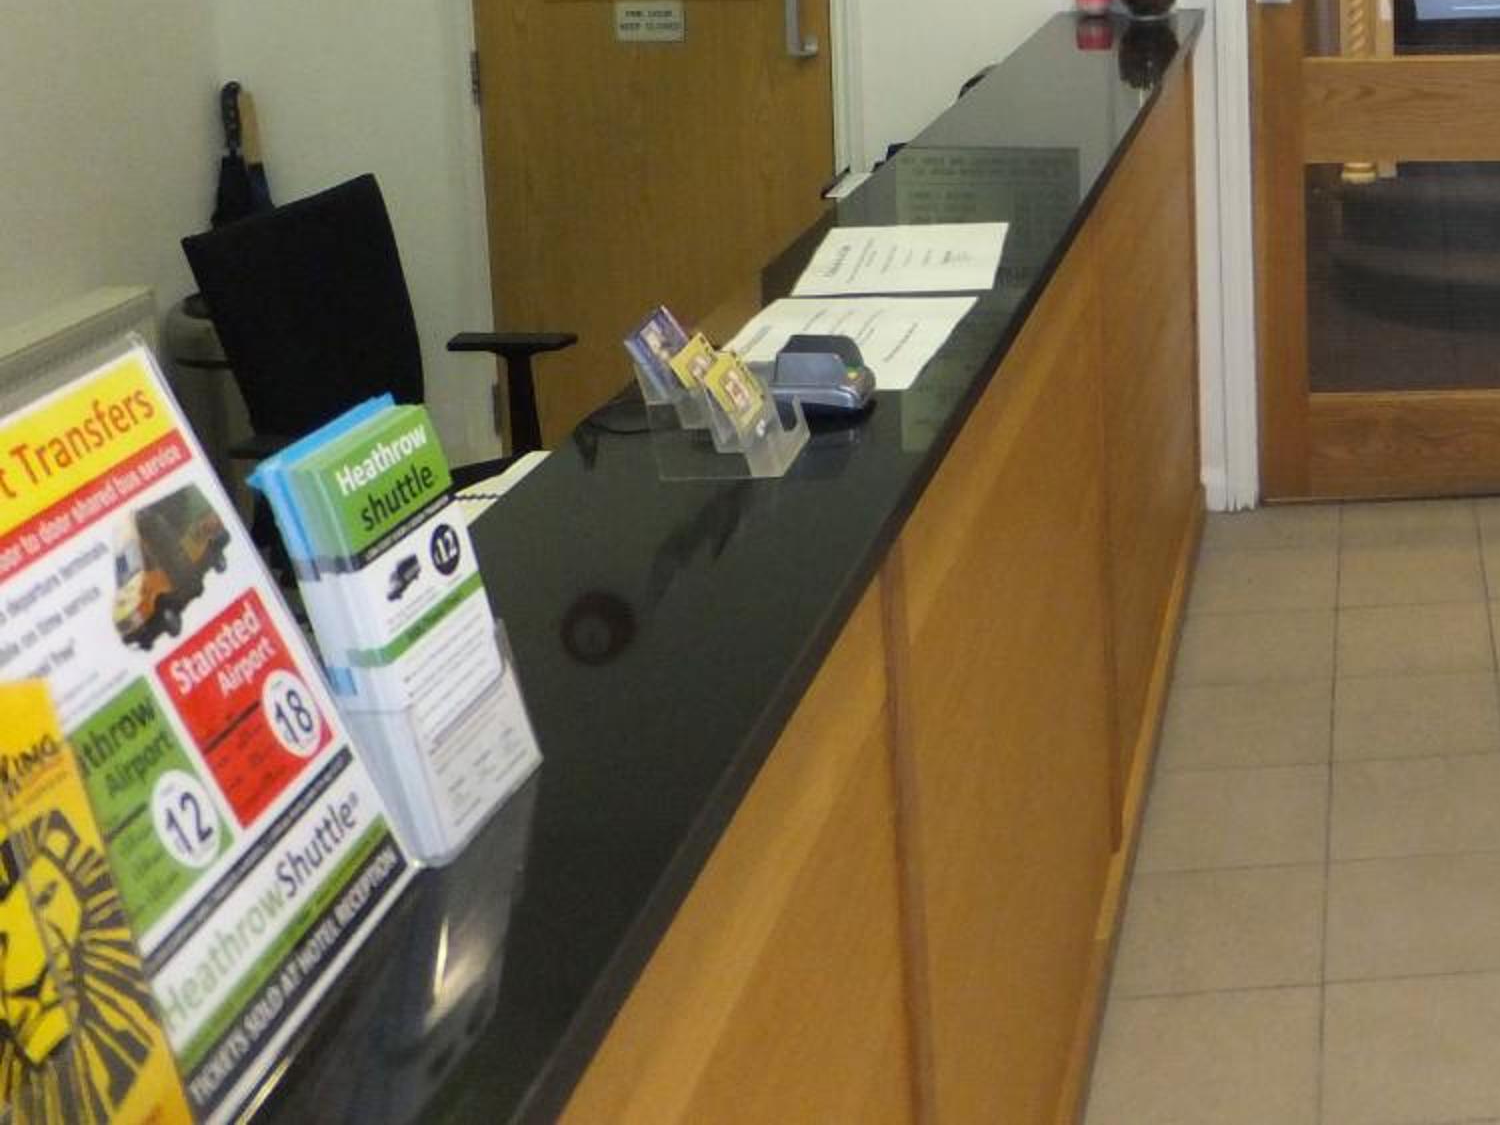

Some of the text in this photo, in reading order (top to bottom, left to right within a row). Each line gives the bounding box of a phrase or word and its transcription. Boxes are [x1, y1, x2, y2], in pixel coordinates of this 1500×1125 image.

[9, 390, 155, 486] Transfers
[335, 424, 428, 497] Heathrow
[360, 463, 434, 532] shuttle
[168, 600, 263, 696] Stansted
[215, 636, 278, 697] Airport
[80, 697, 157, 778] throw
[103, 729, 175, 796] Airport
